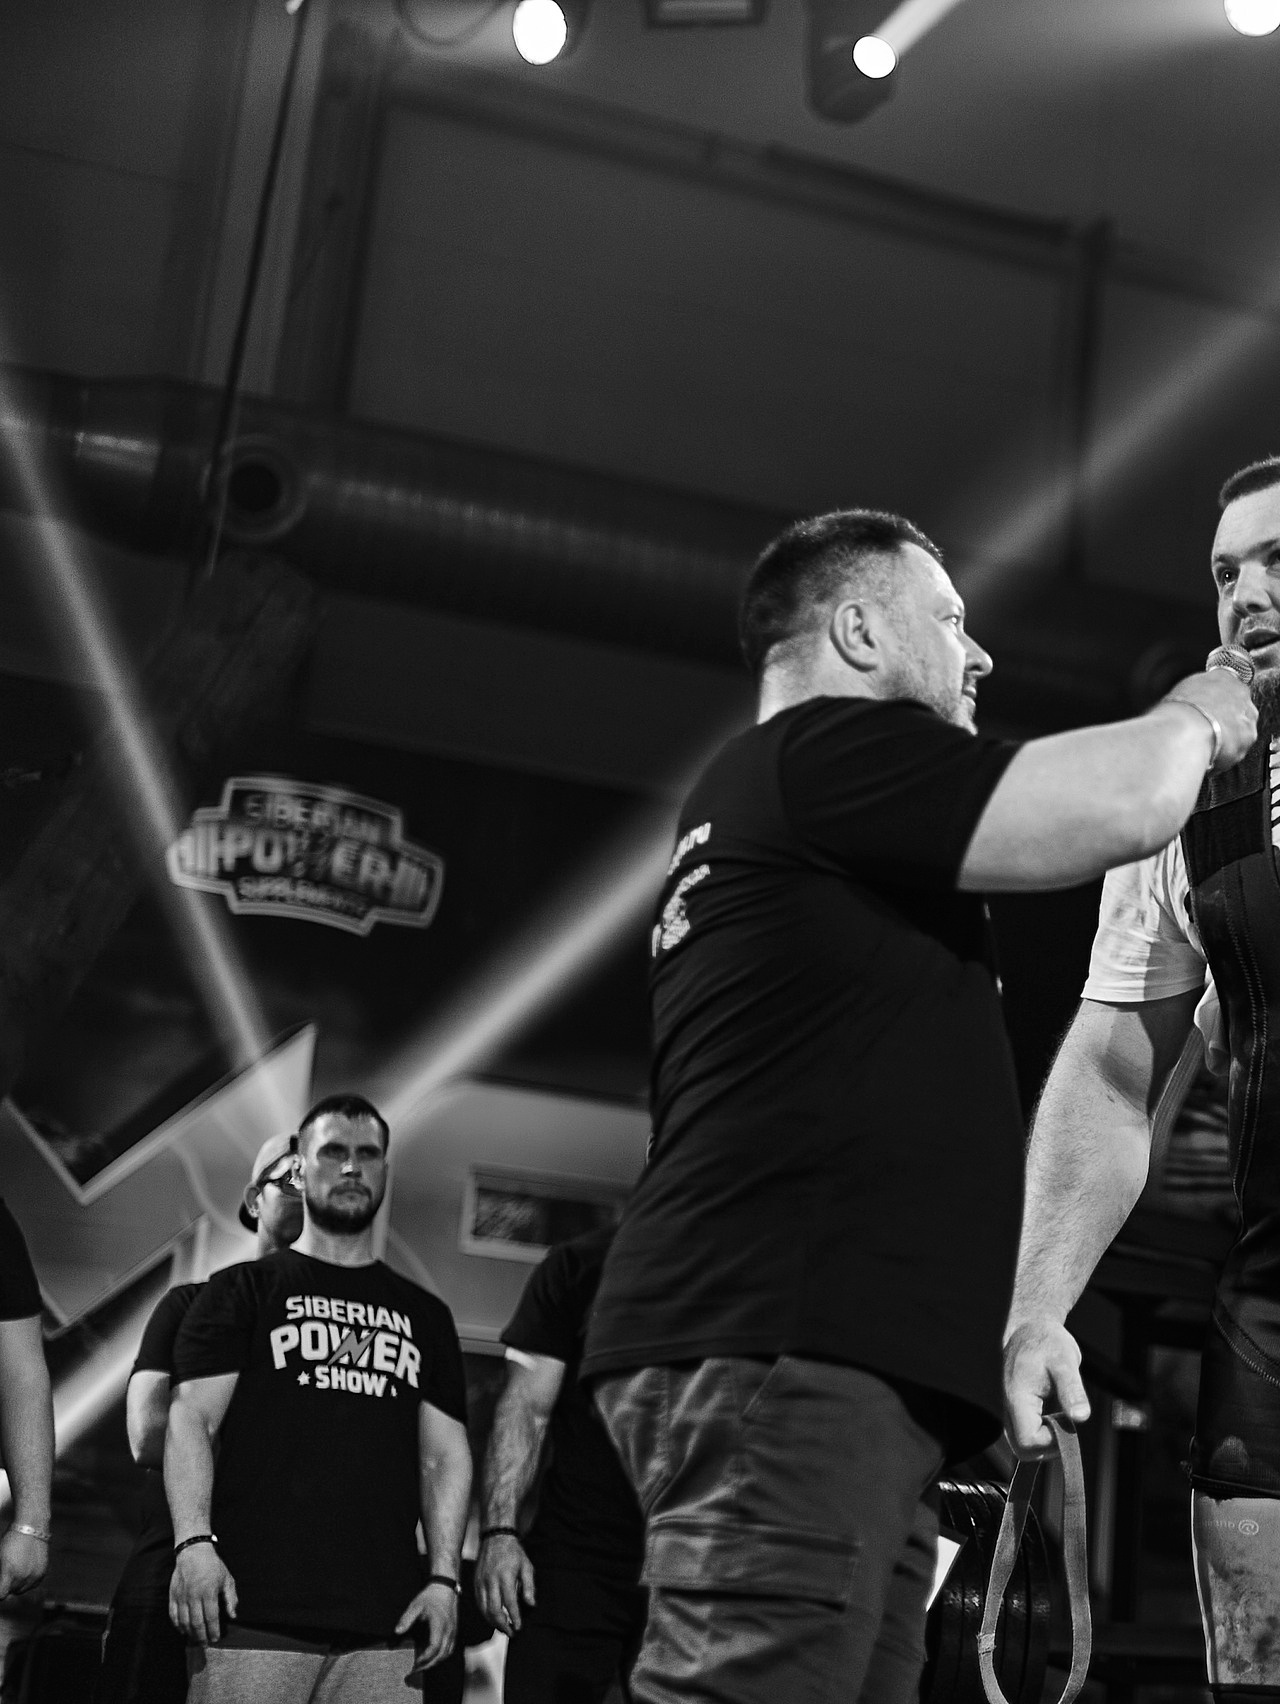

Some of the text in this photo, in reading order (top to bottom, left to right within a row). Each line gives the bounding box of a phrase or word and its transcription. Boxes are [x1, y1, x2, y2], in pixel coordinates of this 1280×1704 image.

[286, 1295, 412, 1338] SIBERIAN
[270, 1321, 421, 1388] POWER
[315, 1364, 388, 1397] SHOW
